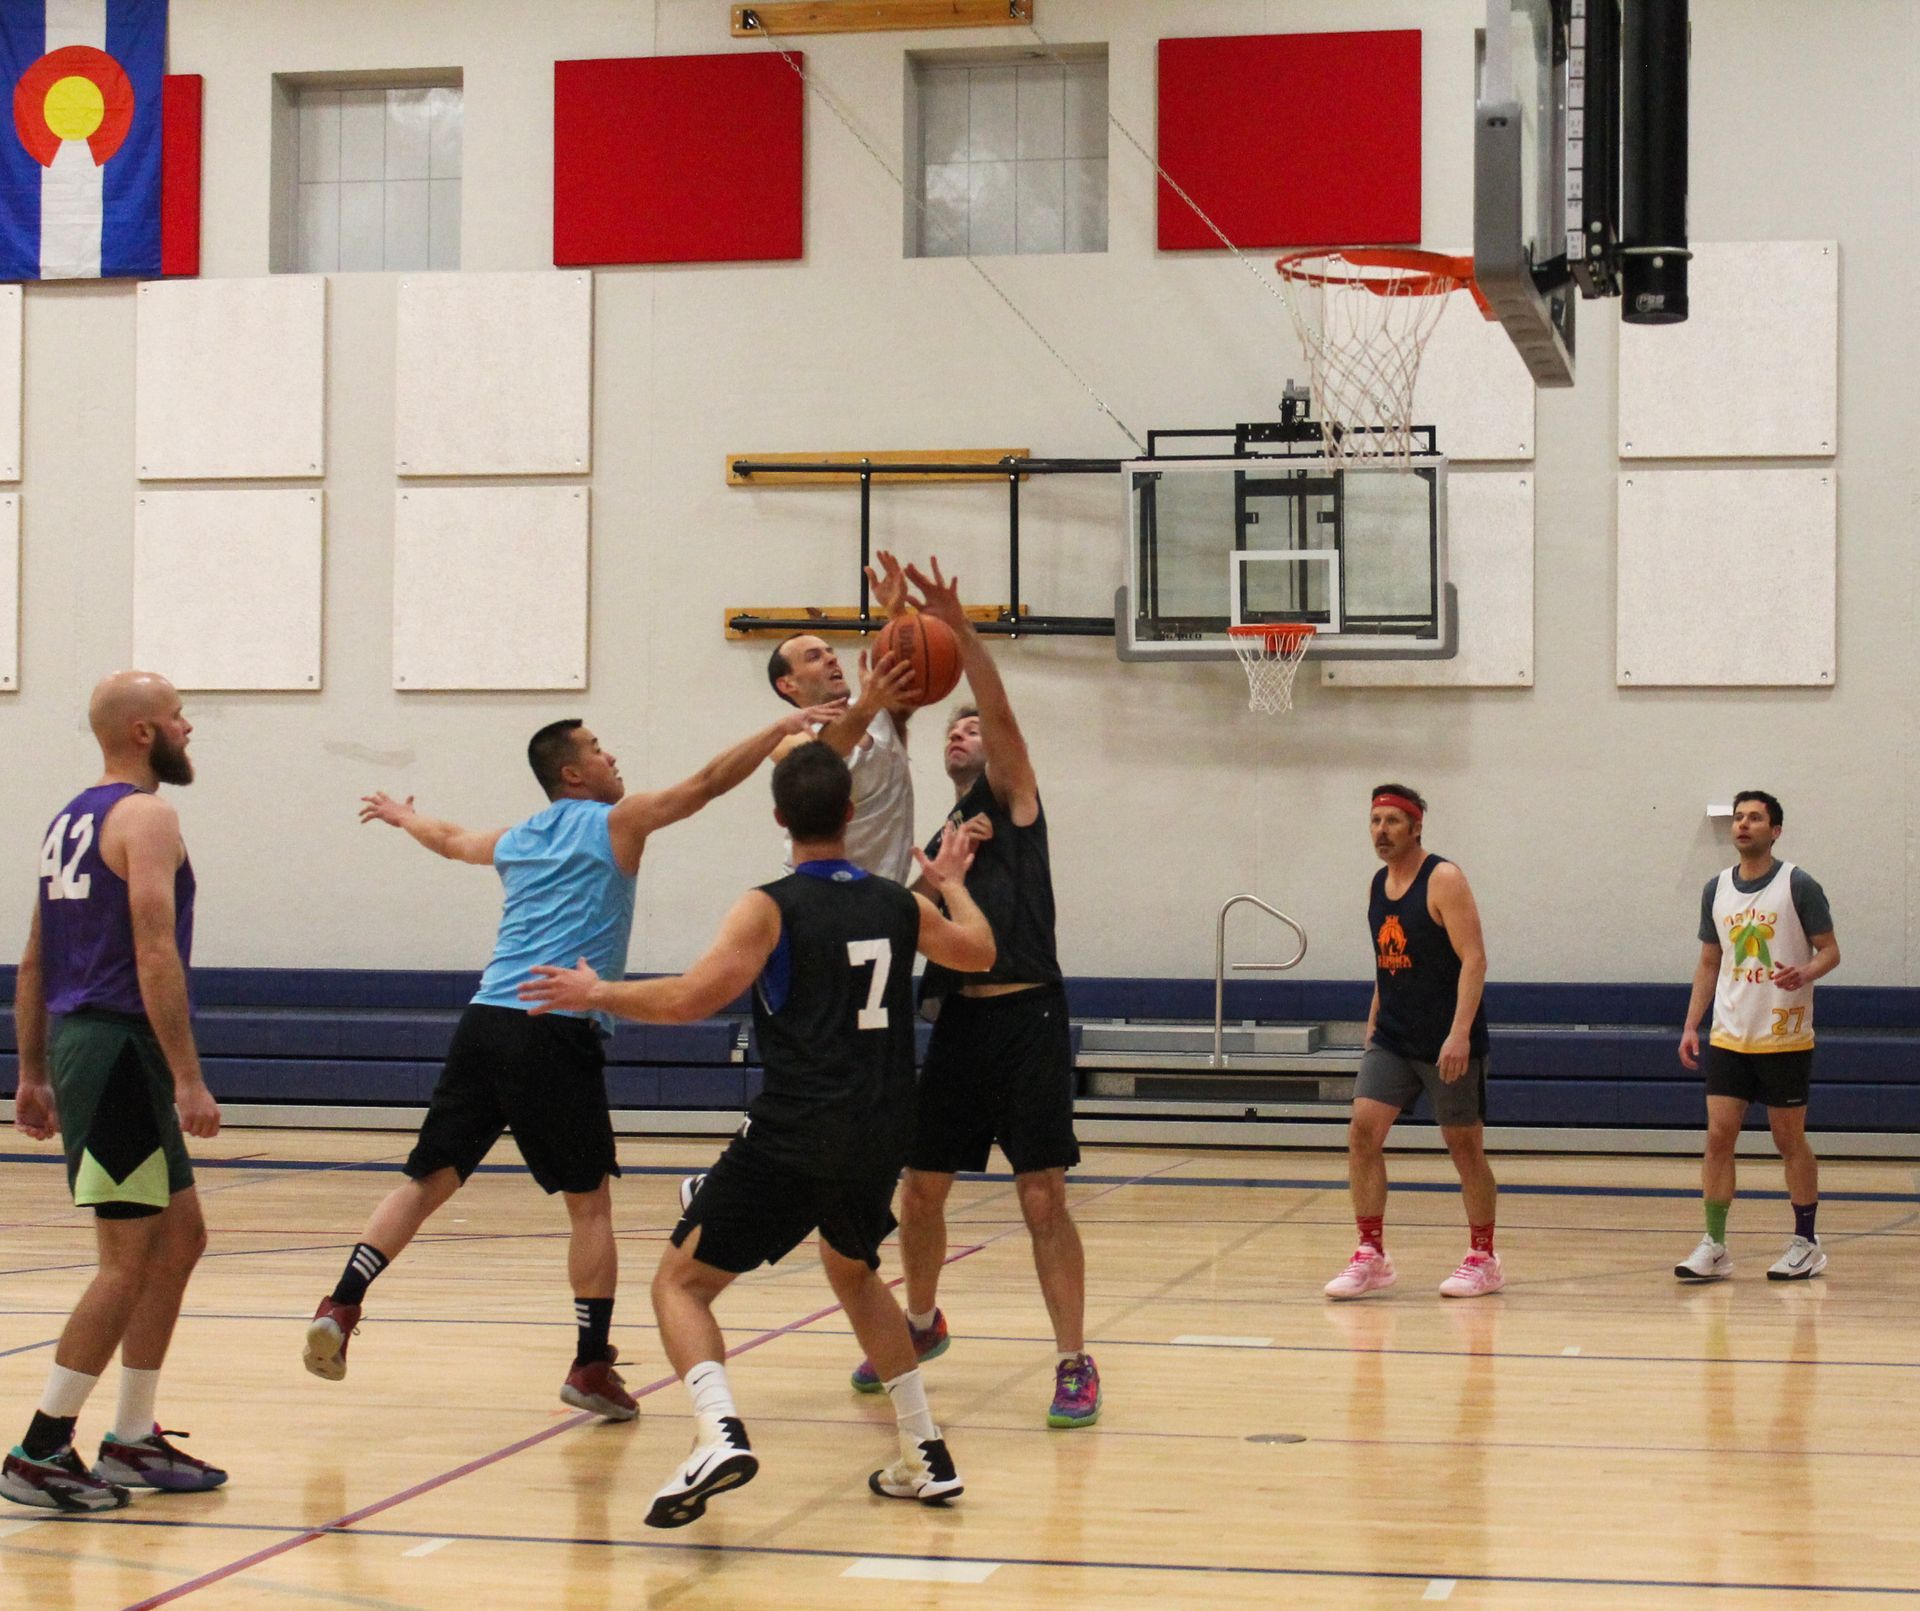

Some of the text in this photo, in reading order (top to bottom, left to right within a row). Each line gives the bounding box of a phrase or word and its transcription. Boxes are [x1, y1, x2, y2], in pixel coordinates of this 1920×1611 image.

[40, 813, 94, 900] 42
[846, 938, 892, 1029] 7
[1771, 1007, 1805, 1036] 27
